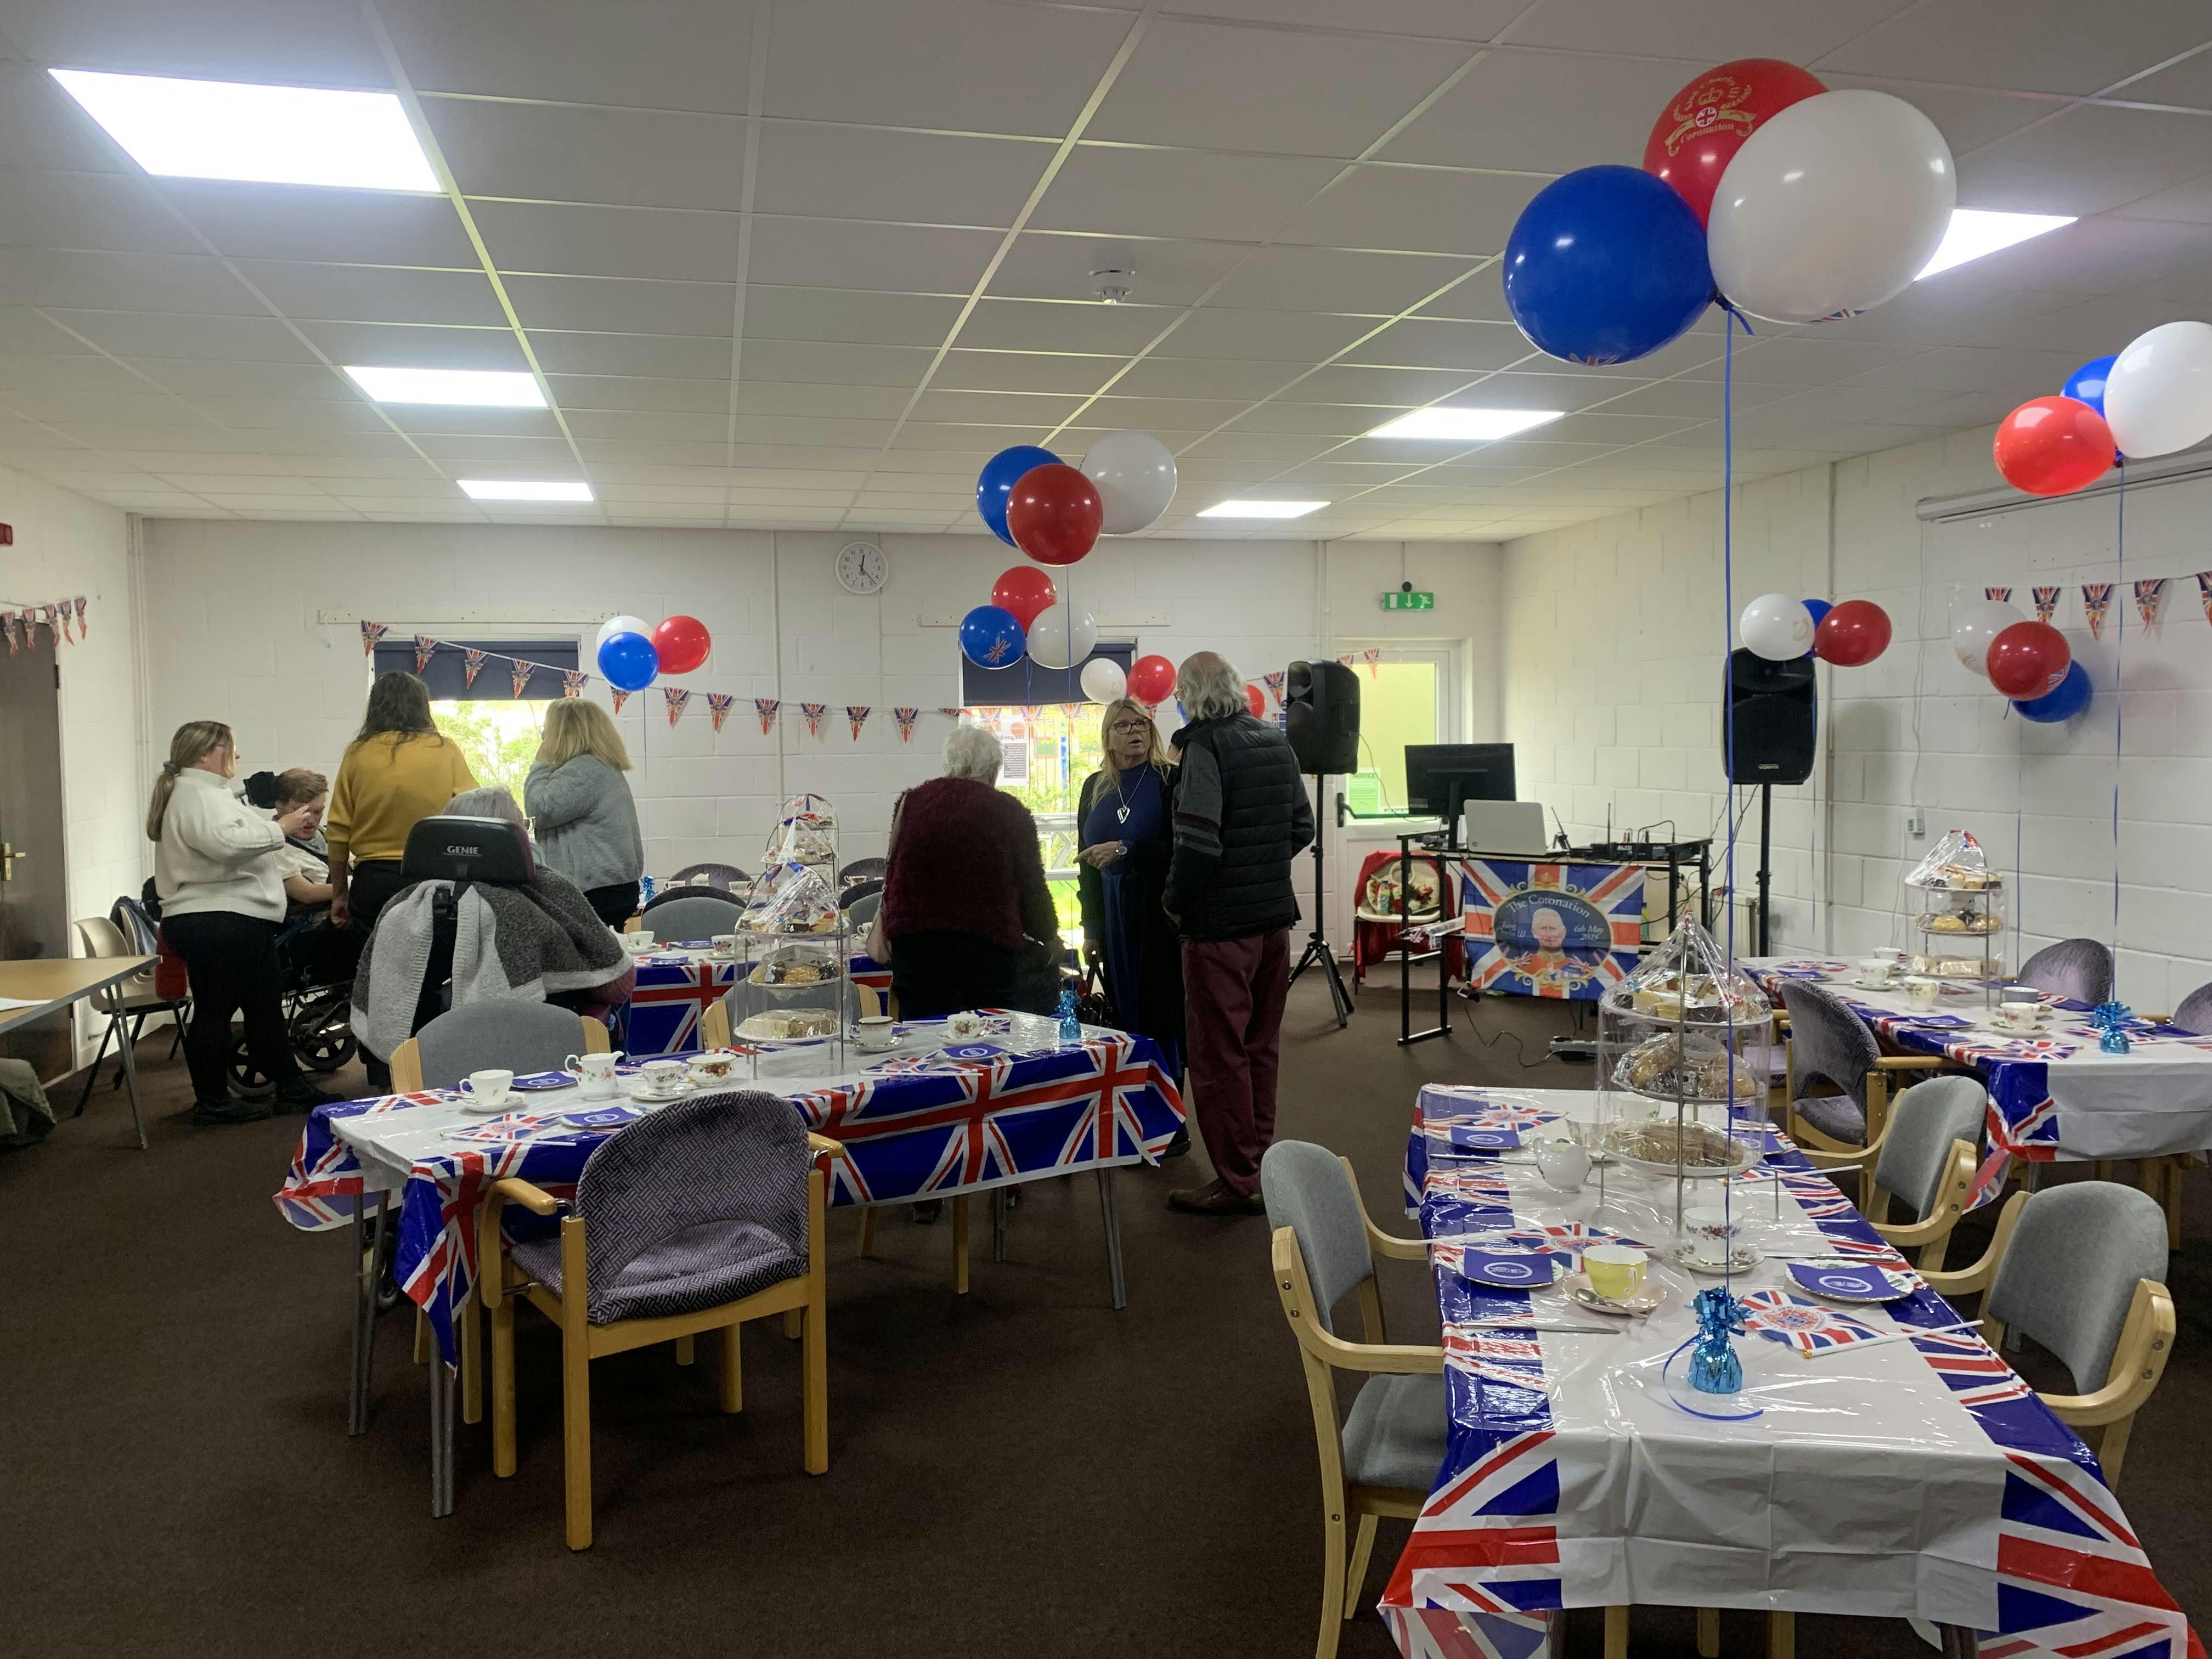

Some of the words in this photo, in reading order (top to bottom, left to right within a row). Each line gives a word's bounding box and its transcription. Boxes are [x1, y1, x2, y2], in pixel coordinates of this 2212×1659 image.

[1680, 123, 1734, 144] Coronation
[447, 845, 479, 855] GENIE
[1506, 900, 1527, 913] The
[1528, 894, 1590, 919] Coronation
[1588, 926, 1604, 934] May
